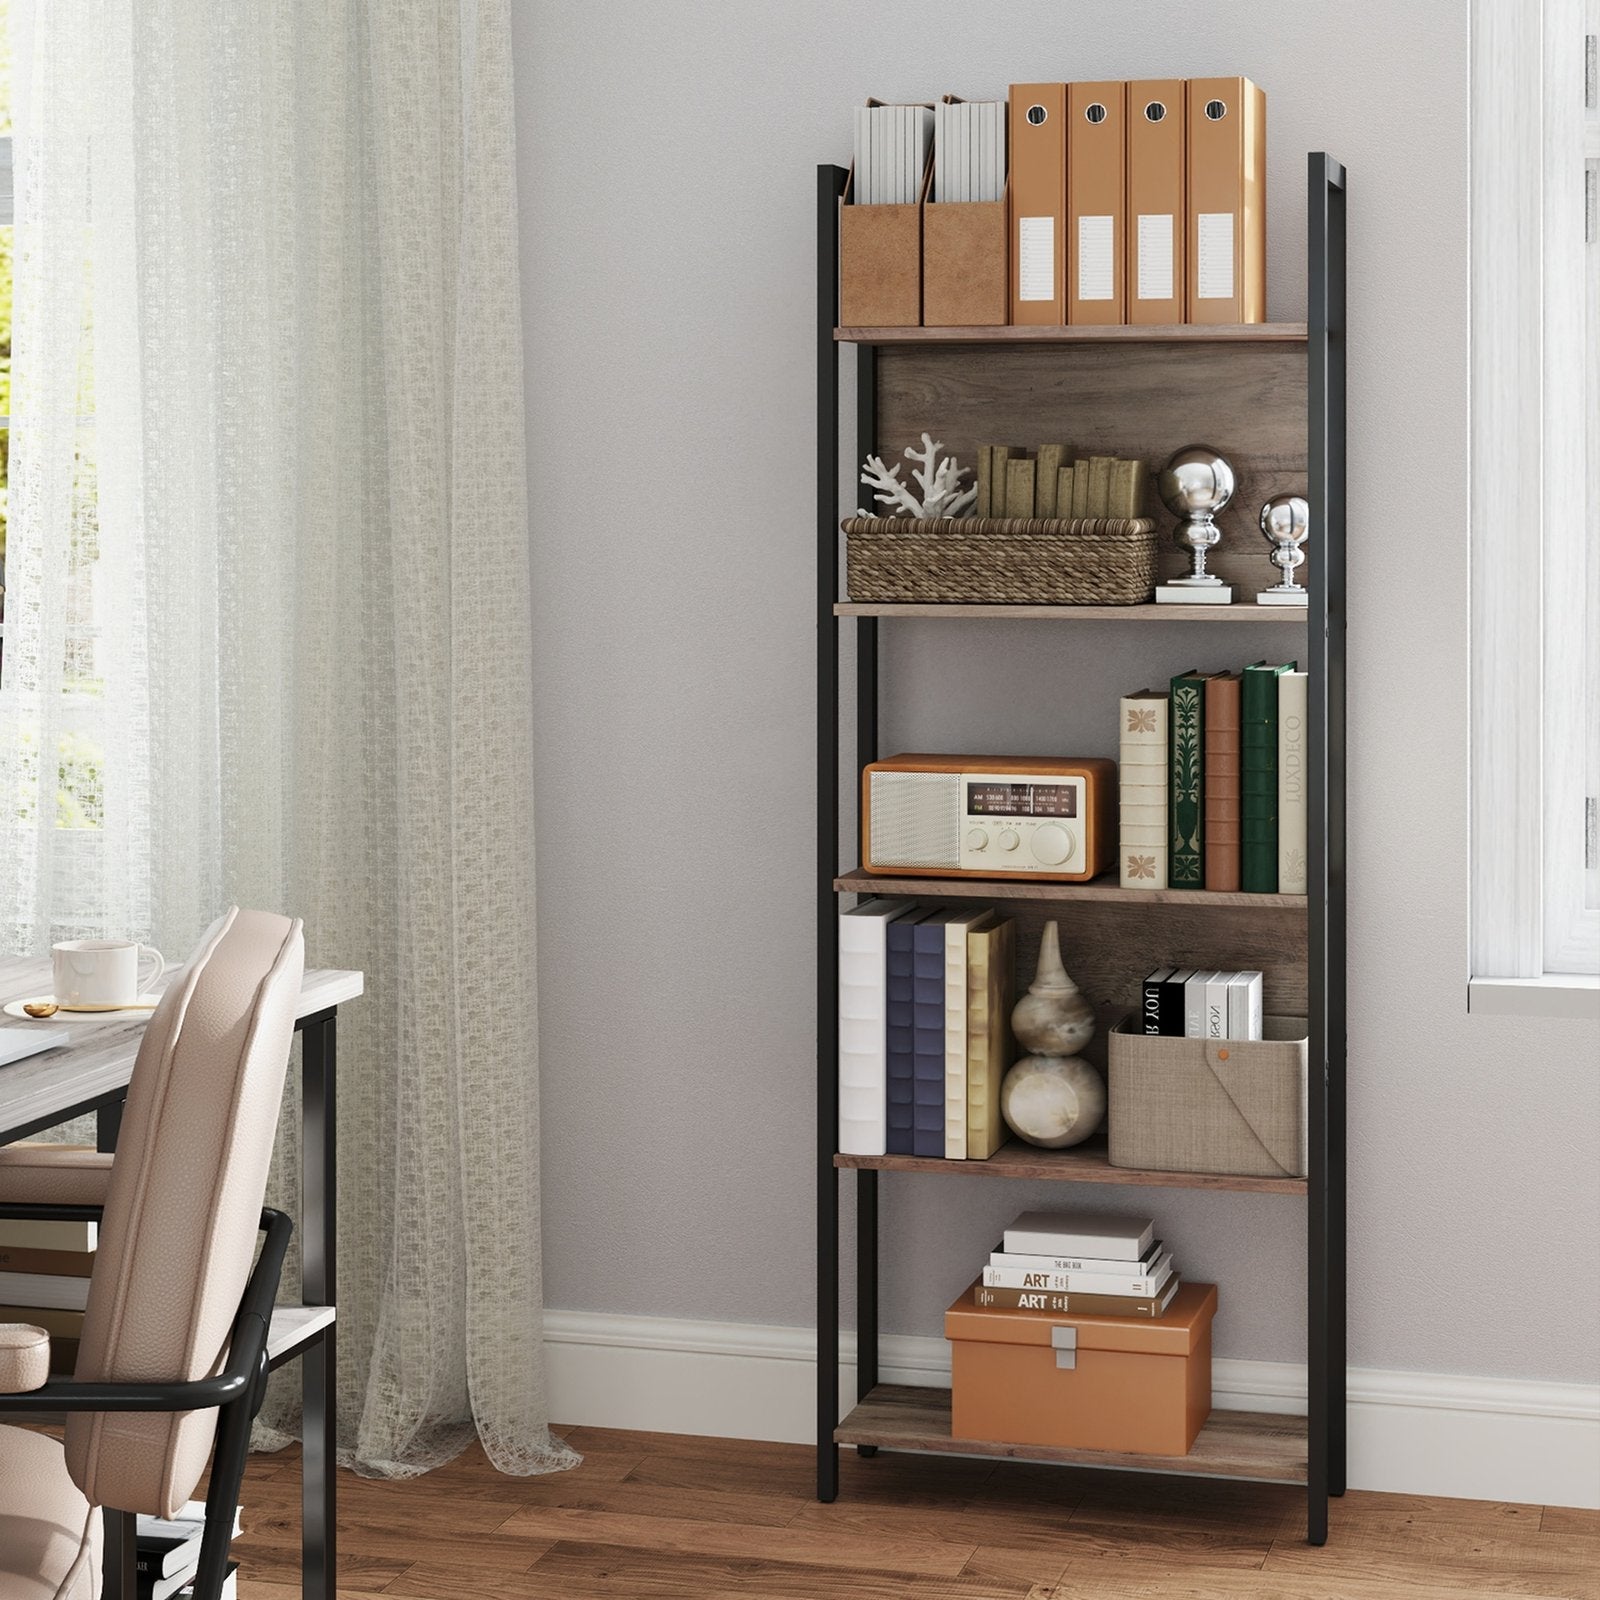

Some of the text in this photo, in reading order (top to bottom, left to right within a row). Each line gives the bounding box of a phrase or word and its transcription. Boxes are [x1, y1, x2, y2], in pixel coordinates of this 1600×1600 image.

[1285, 715, 1301, 803] LUXDECO
[1023, 1273, 1050, 1288] ART
[1018, 1294, 1047, 1309] ART
